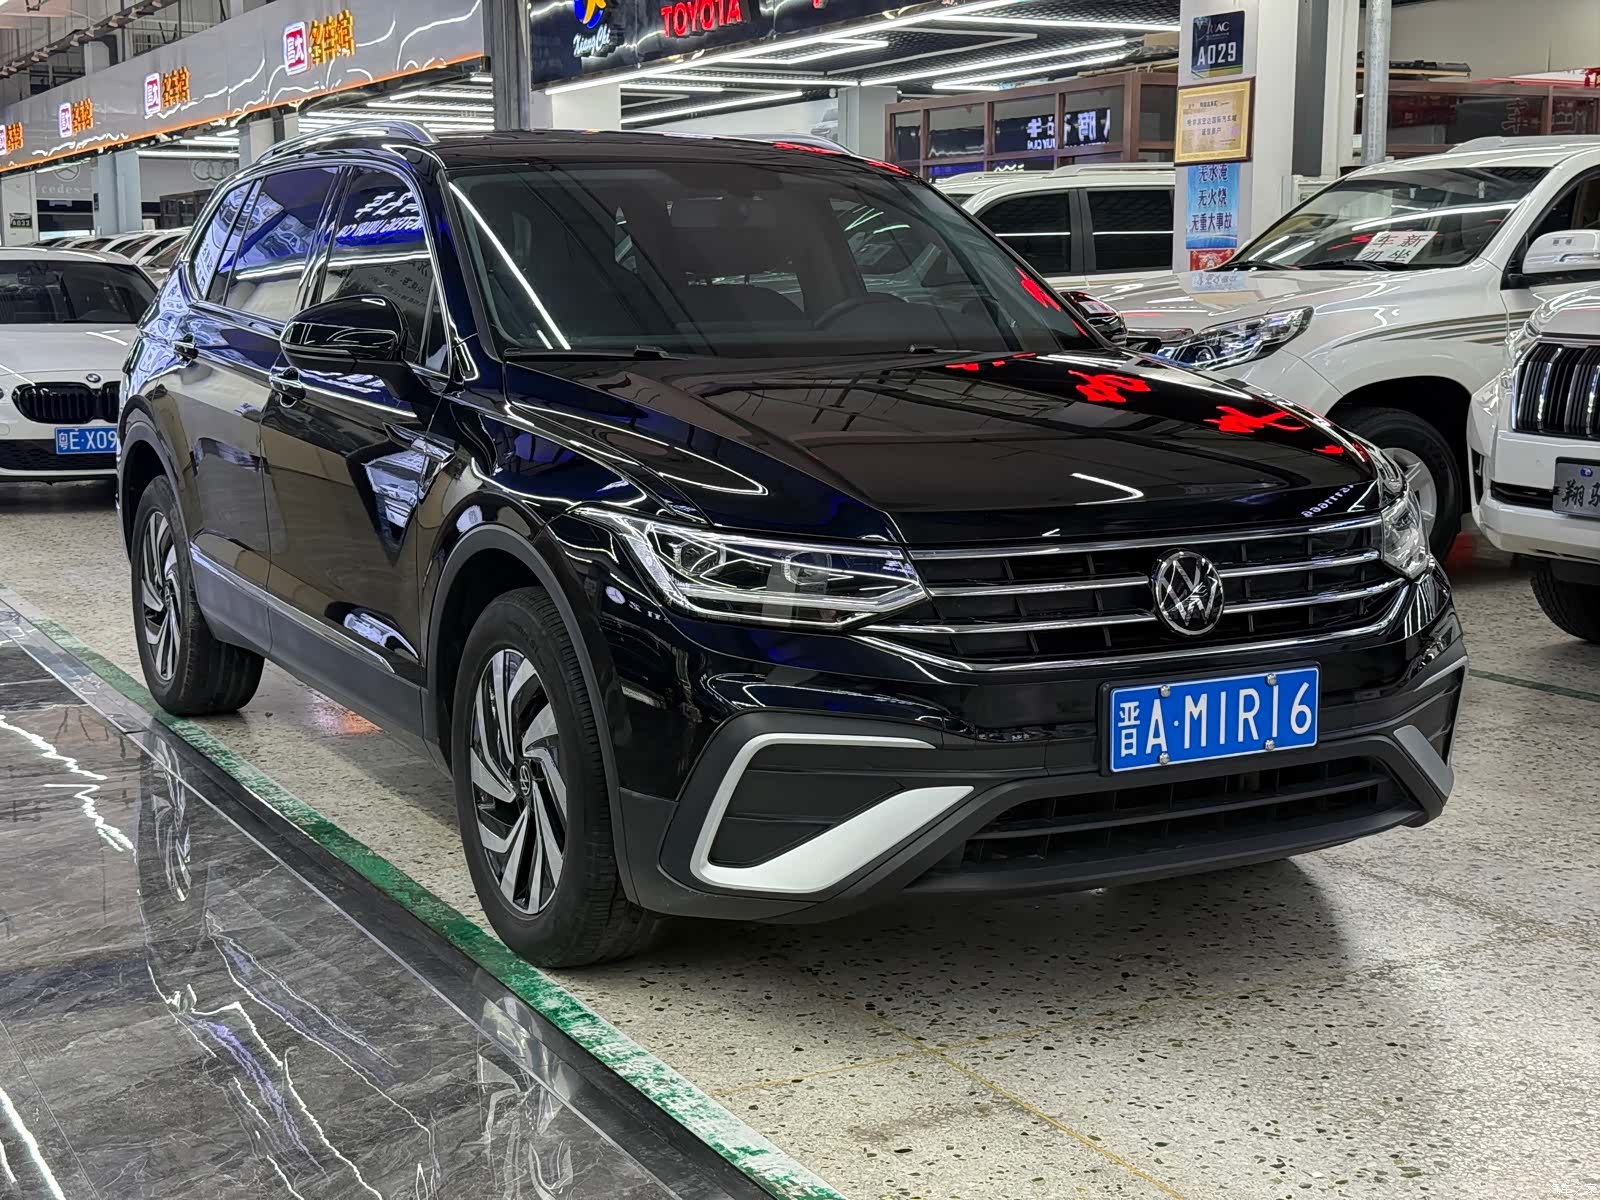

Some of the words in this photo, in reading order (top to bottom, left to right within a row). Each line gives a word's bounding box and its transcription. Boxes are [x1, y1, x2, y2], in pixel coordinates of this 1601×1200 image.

[661, 0, 742, 38] TOYOTA
[1197, 42, 1236, 66] A029
[1198, 187, 1227, 206] 无火烧
[1191, 212, 1232, 232] 无重大事故
